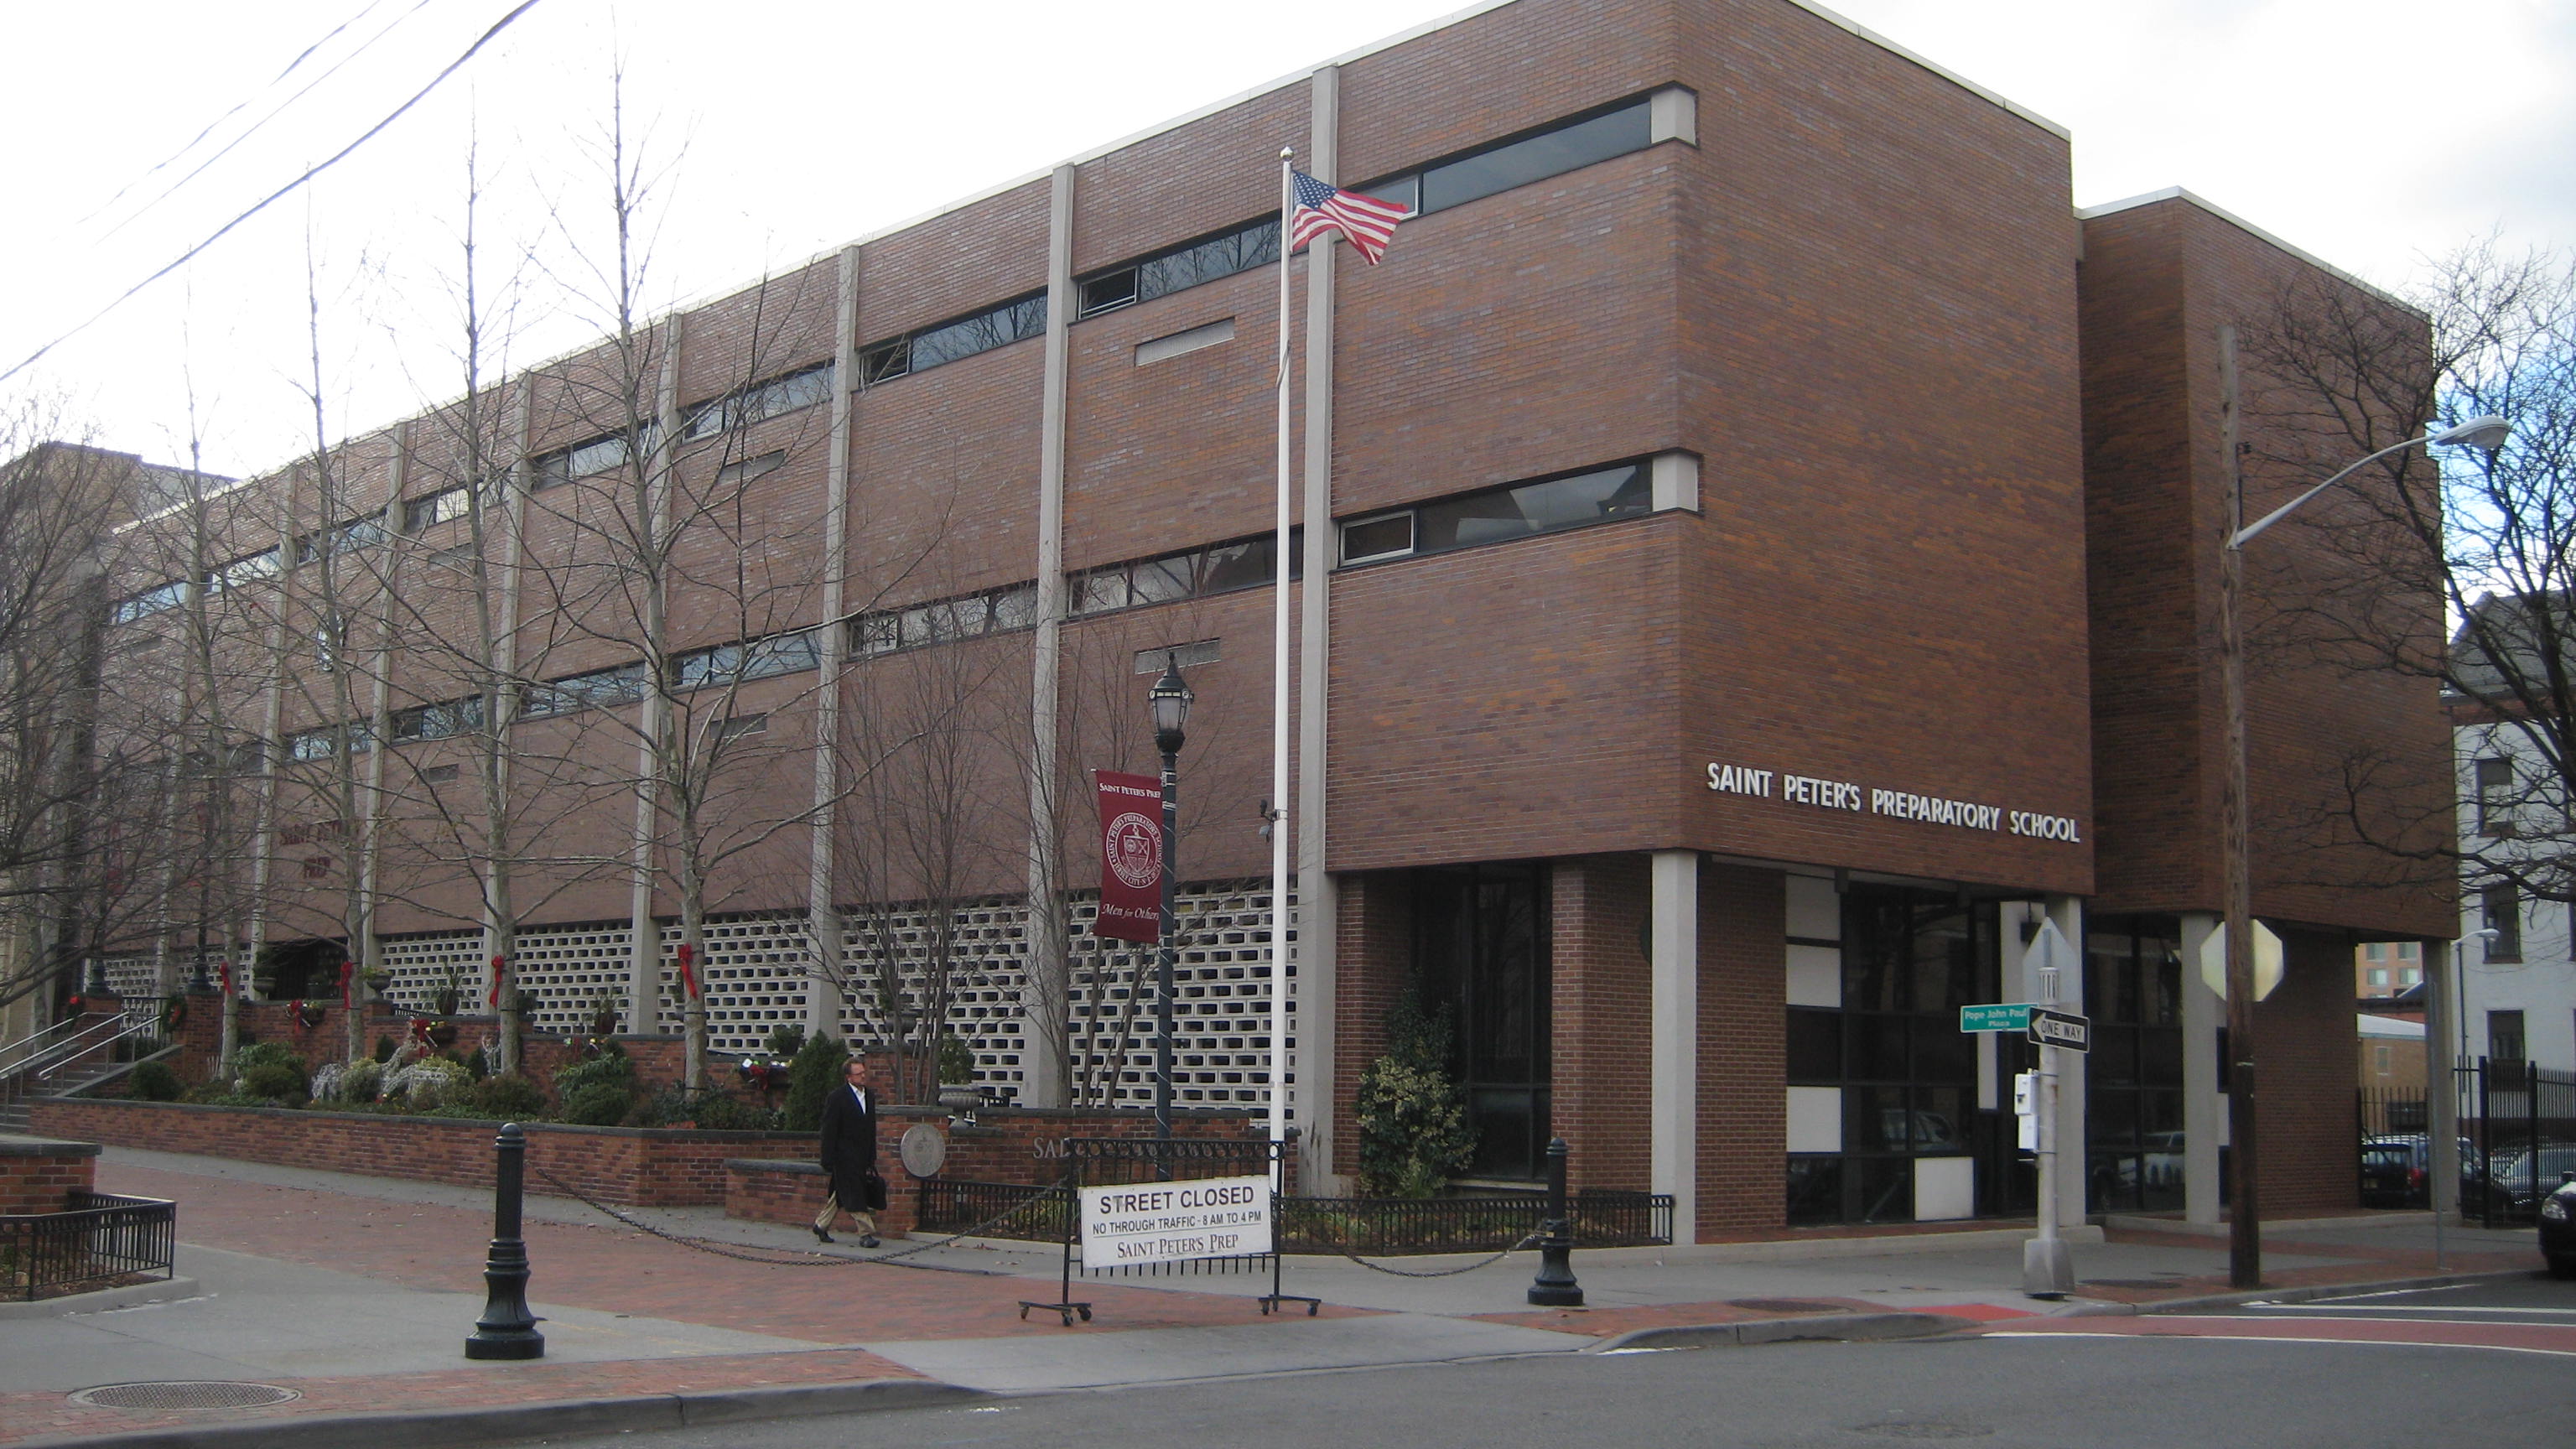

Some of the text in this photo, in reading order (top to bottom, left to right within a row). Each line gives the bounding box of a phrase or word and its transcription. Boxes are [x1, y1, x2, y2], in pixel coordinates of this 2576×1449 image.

[1706, 762, 2080, 844] SAINT PETER'S PREPARATORY SCHOOL
[1101, 903, 1123, 916] Men
[1135, 907, 1159, 921] Others
[1965, 1008, 2027, 1021] Pope John Paul
[2040, 1020, 2081, 1040] ONE WAY
[1100, 1186, 1254, 1214] STREET CLOSED
[1093, 1223, 1106, 1235] NO
[1109, 1218, 1155, 1233] THROUGH
[1158, 1215, 1196, 1230] TRAFFIC
[1202, 1214, 1208, 1226] 8
[1210, 1213, 1223, 1225] AM
[1227, 1213, 1239, 1223] TO
[1241, 1212, 1246, 1223] 4
[1249, 1210, 1261, 1222] PM
[1117, 1233, 1239, 1259] SAINT PETER'S PREP
